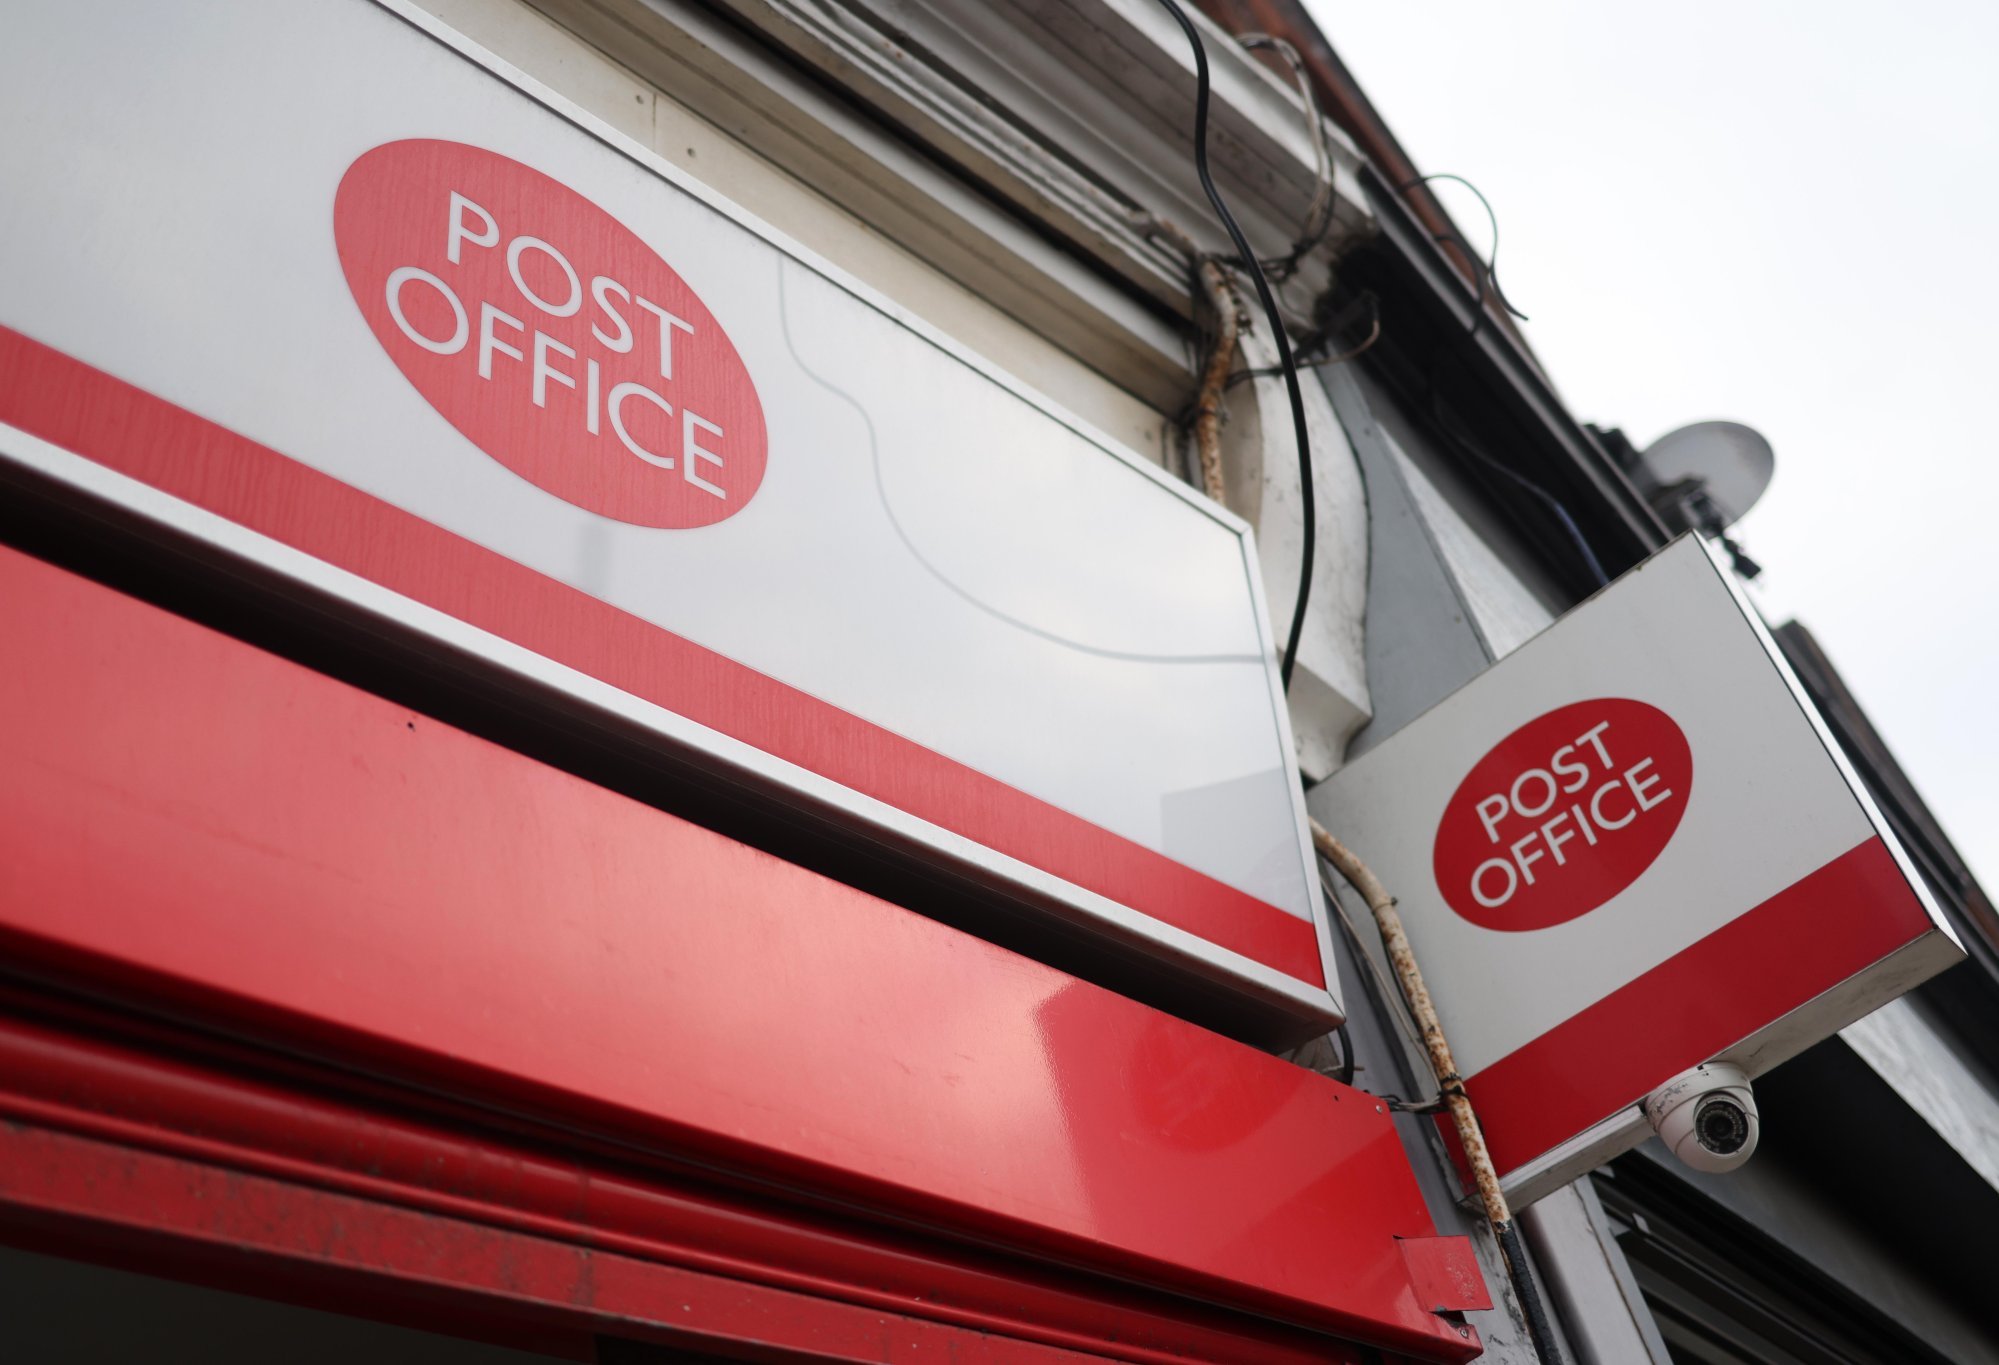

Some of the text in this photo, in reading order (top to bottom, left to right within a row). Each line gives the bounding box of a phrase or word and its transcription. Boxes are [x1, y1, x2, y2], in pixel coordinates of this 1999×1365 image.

[447, 190, 694, 380] POST
[386, 266, 726, 500] OFFICE
[1471, 757, 1672, 907] OFFICE
[1475, 720, 1614, 844] POST
